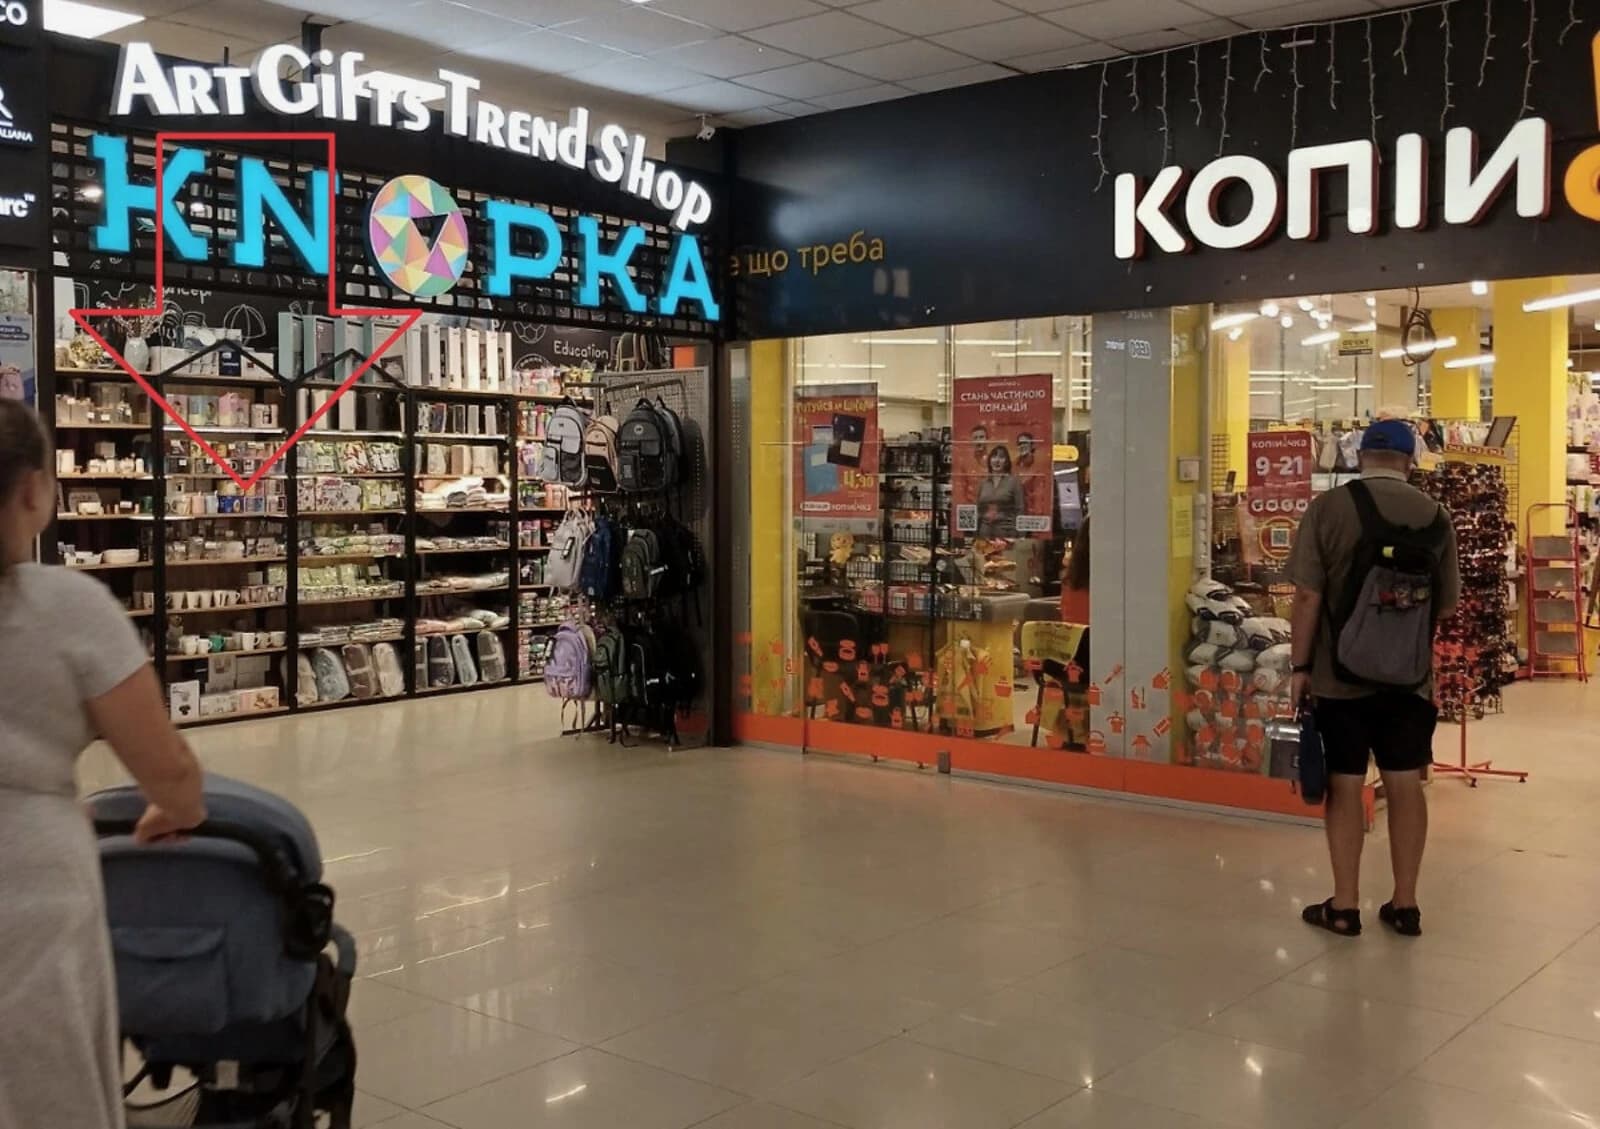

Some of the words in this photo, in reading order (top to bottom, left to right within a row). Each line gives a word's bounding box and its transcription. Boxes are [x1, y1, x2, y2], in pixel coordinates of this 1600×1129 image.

[749, 249, 789, 277] що
[797, 231, 884, 276] треба
[553, 340, 609, 359] Education
[960, 392, 989, 402] СТАНЬ
[990, 389, 1046, 401] ЧАСТИНОЮ
[979, 402, 1028, 413] КОМАНДИ
